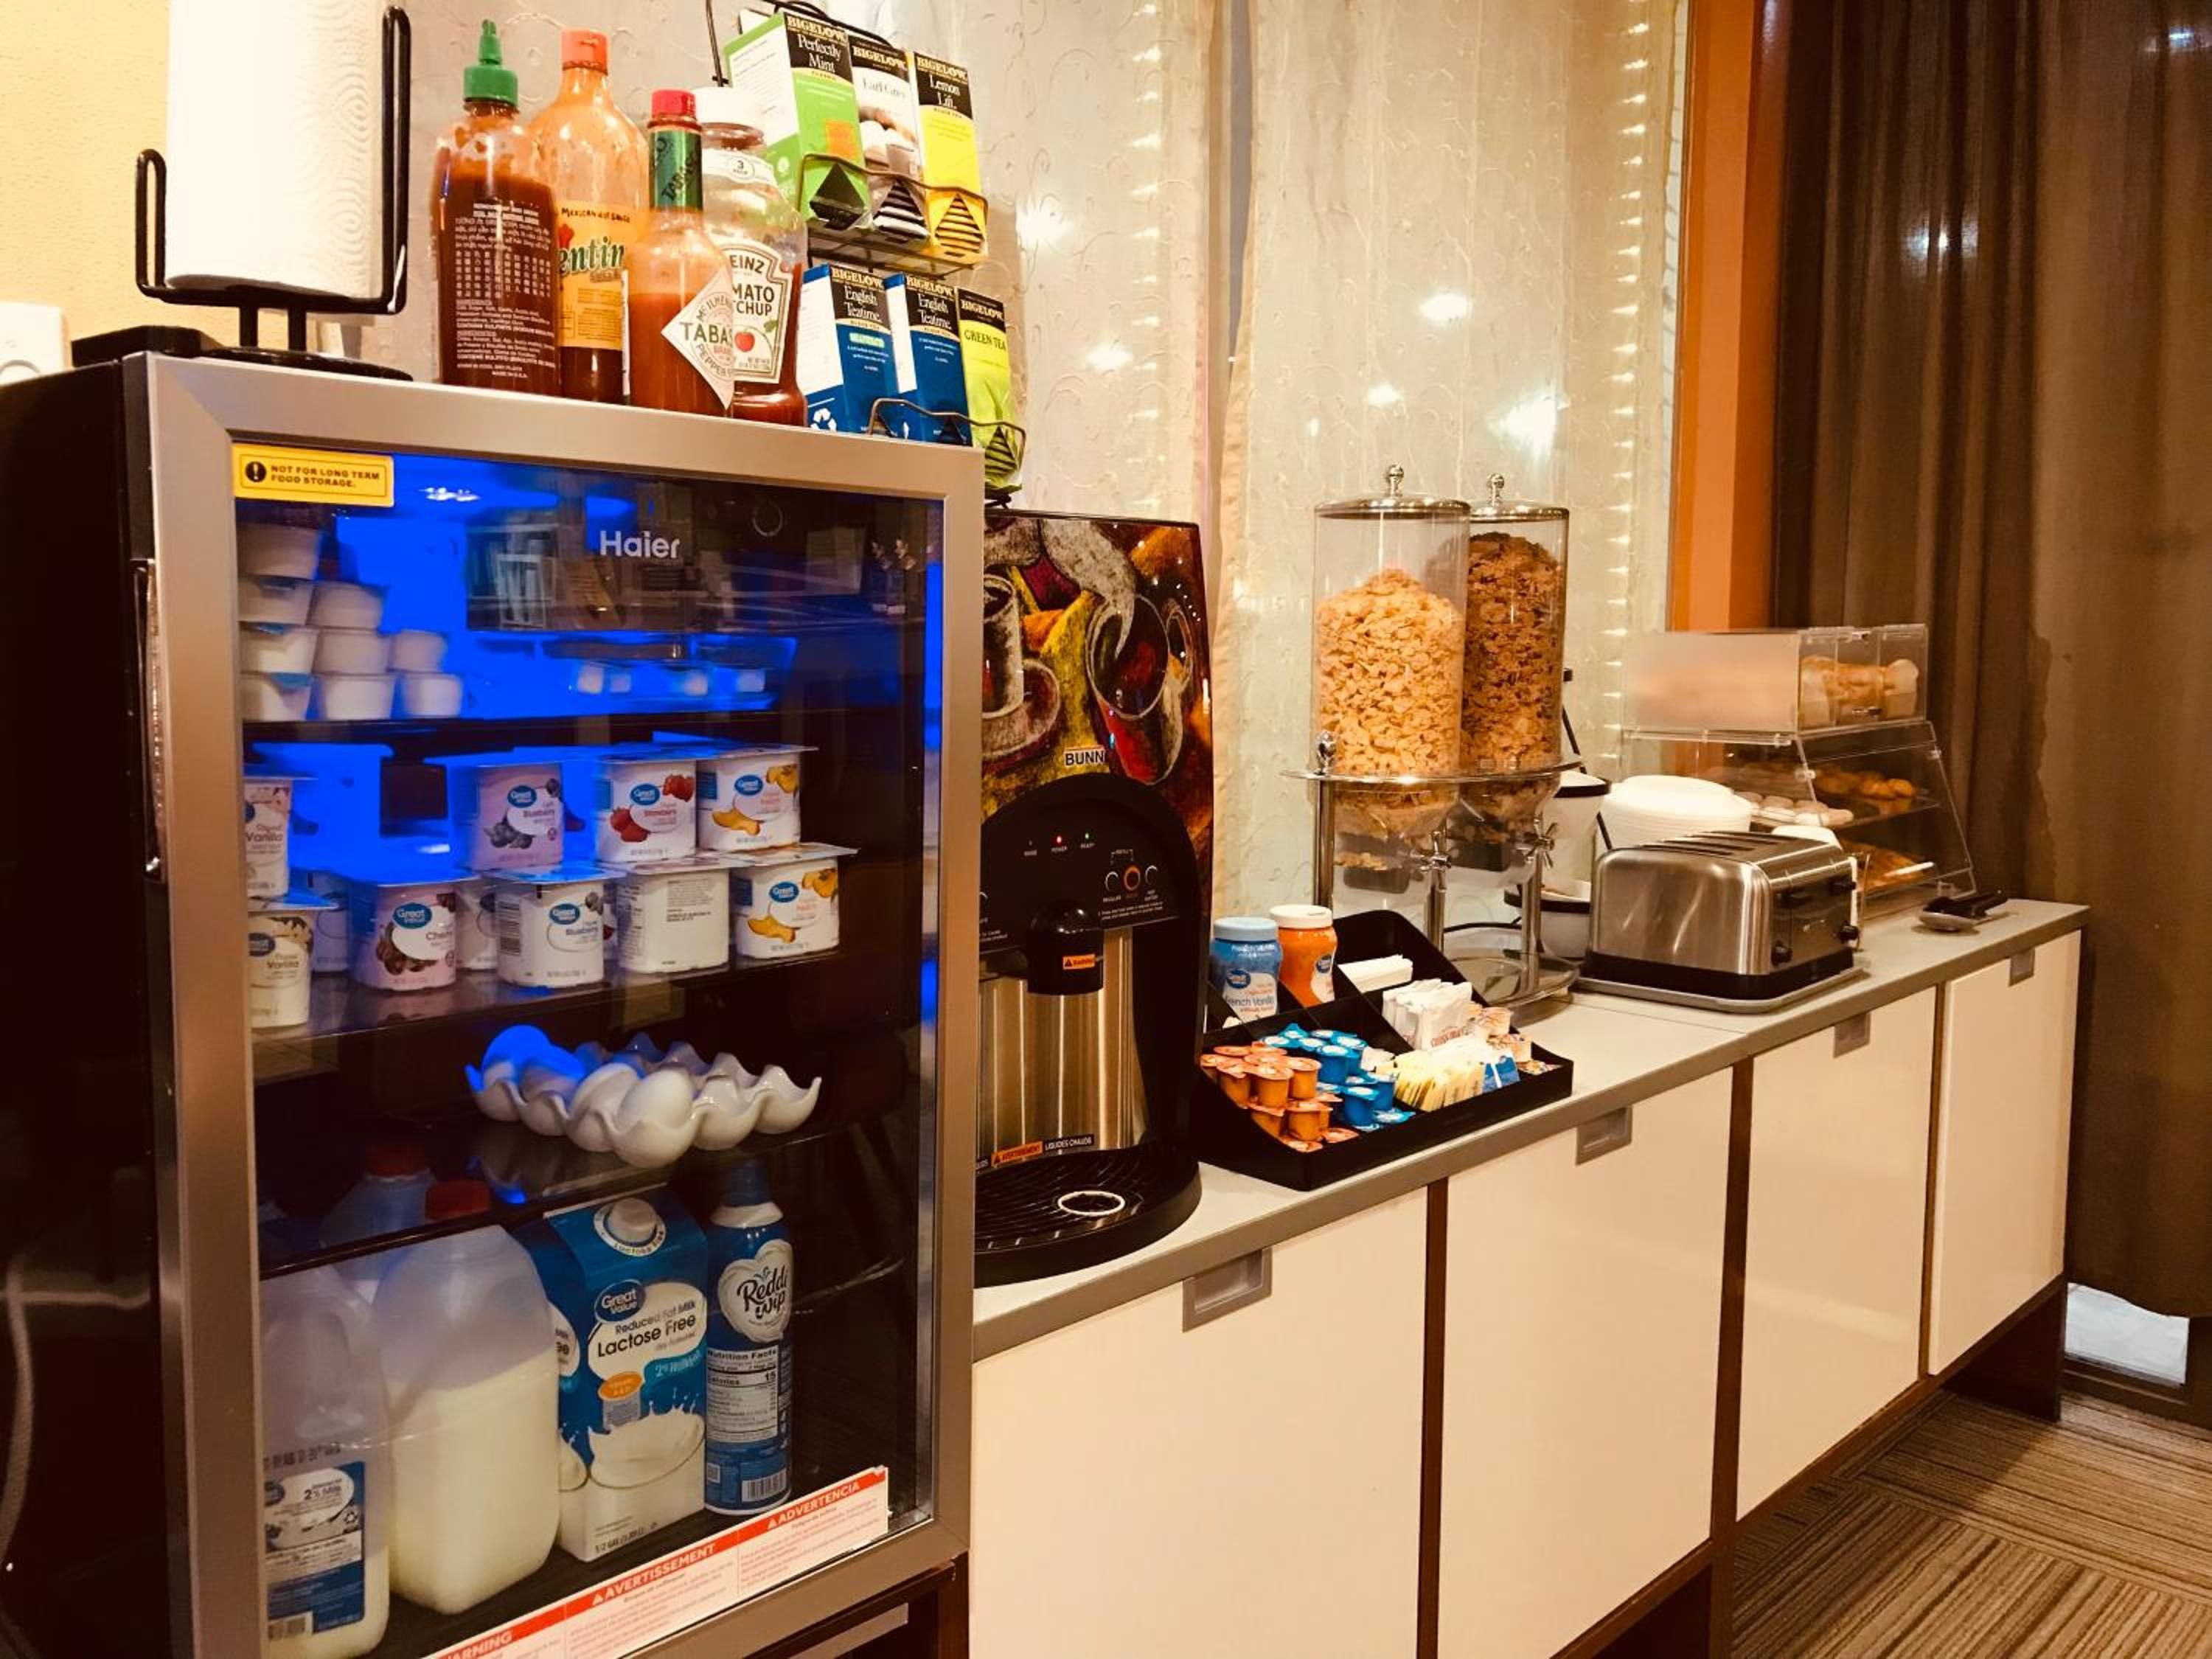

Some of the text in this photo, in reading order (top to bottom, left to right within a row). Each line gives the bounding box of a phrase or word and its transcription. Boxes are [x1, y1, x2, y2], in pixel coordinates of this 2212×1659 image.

[787, 15, 848, 42] BIGELOW
[797, 33, 843, 61] Perfectly
[809, 54, 836, 74] Mint
[853, 46, 908, 71] BIGELOW
[917, 56, 968, 80] BIGELOW
[929, 76, 961, 96] Lemon
[730, 254, 765, 274] EINZ
[832, 268, 883, 288] BIGELOW
[906, 276, 954, 296] BIGELOW
[731, 283, 775, 303] MATO
[844, 285, 878, 305] English
[918, 293, 949, 313] English
[961, 299, 1004, 320] BIGELOW
[680, 322, 733, 344] TABA
[964, 330, 1006, 351] GREEN TEA
[271, 465, 380, 480] NOT FOR LONG TERM
[271, 474, 301, 484] FOOD
[599, 530, 681, 559] Haier
[1065, 750, 1105, 766] BUNN
[601, 1288, 638, 1309] Great
[737, 1265, 788, 1312] Reddi
[614, 1314, 661, 1335] Reduced
[677, 1299, 696, 1314] Milk
[597, 1326, 661, 1357] Lactose
[664, 1314, 696, 1337] Free
[751, 1349, 776, 1359] Facts
[776, 1482, 861, 1523] ADVERTENCIA
[605, 1543, 717, 1601] AVERTISSEMENT
[446, 1630, 513, 1659] ARNING
